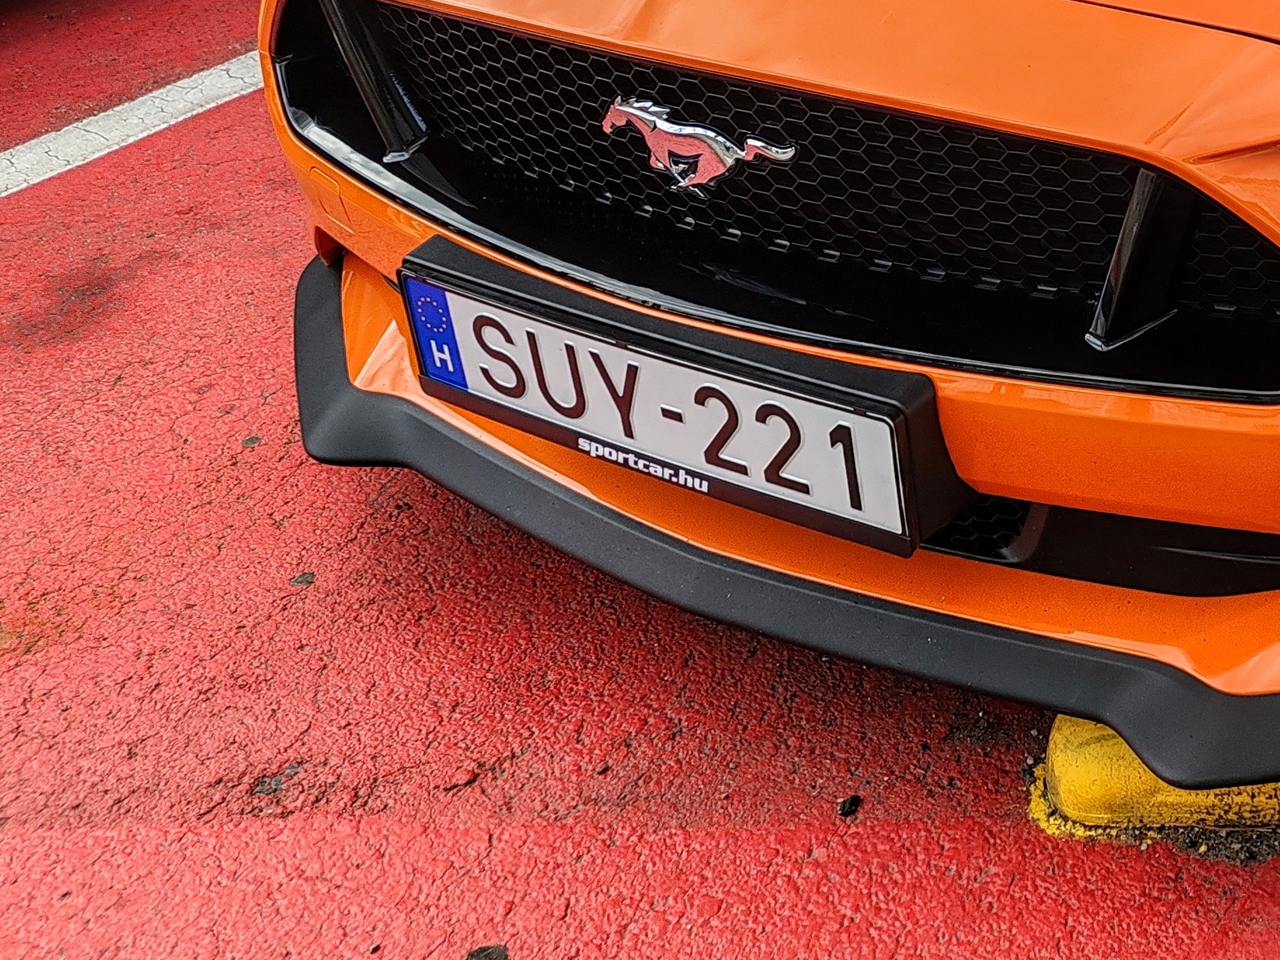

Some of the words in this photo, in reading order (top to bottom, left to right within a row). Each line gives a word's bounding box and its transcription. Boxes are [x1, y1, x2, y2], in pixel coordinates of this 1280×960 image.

[430, 339, 454, 372] H
[471, 314, 863, 512] SUY-221
[577, 437, 709, 493] sportcar.hu
